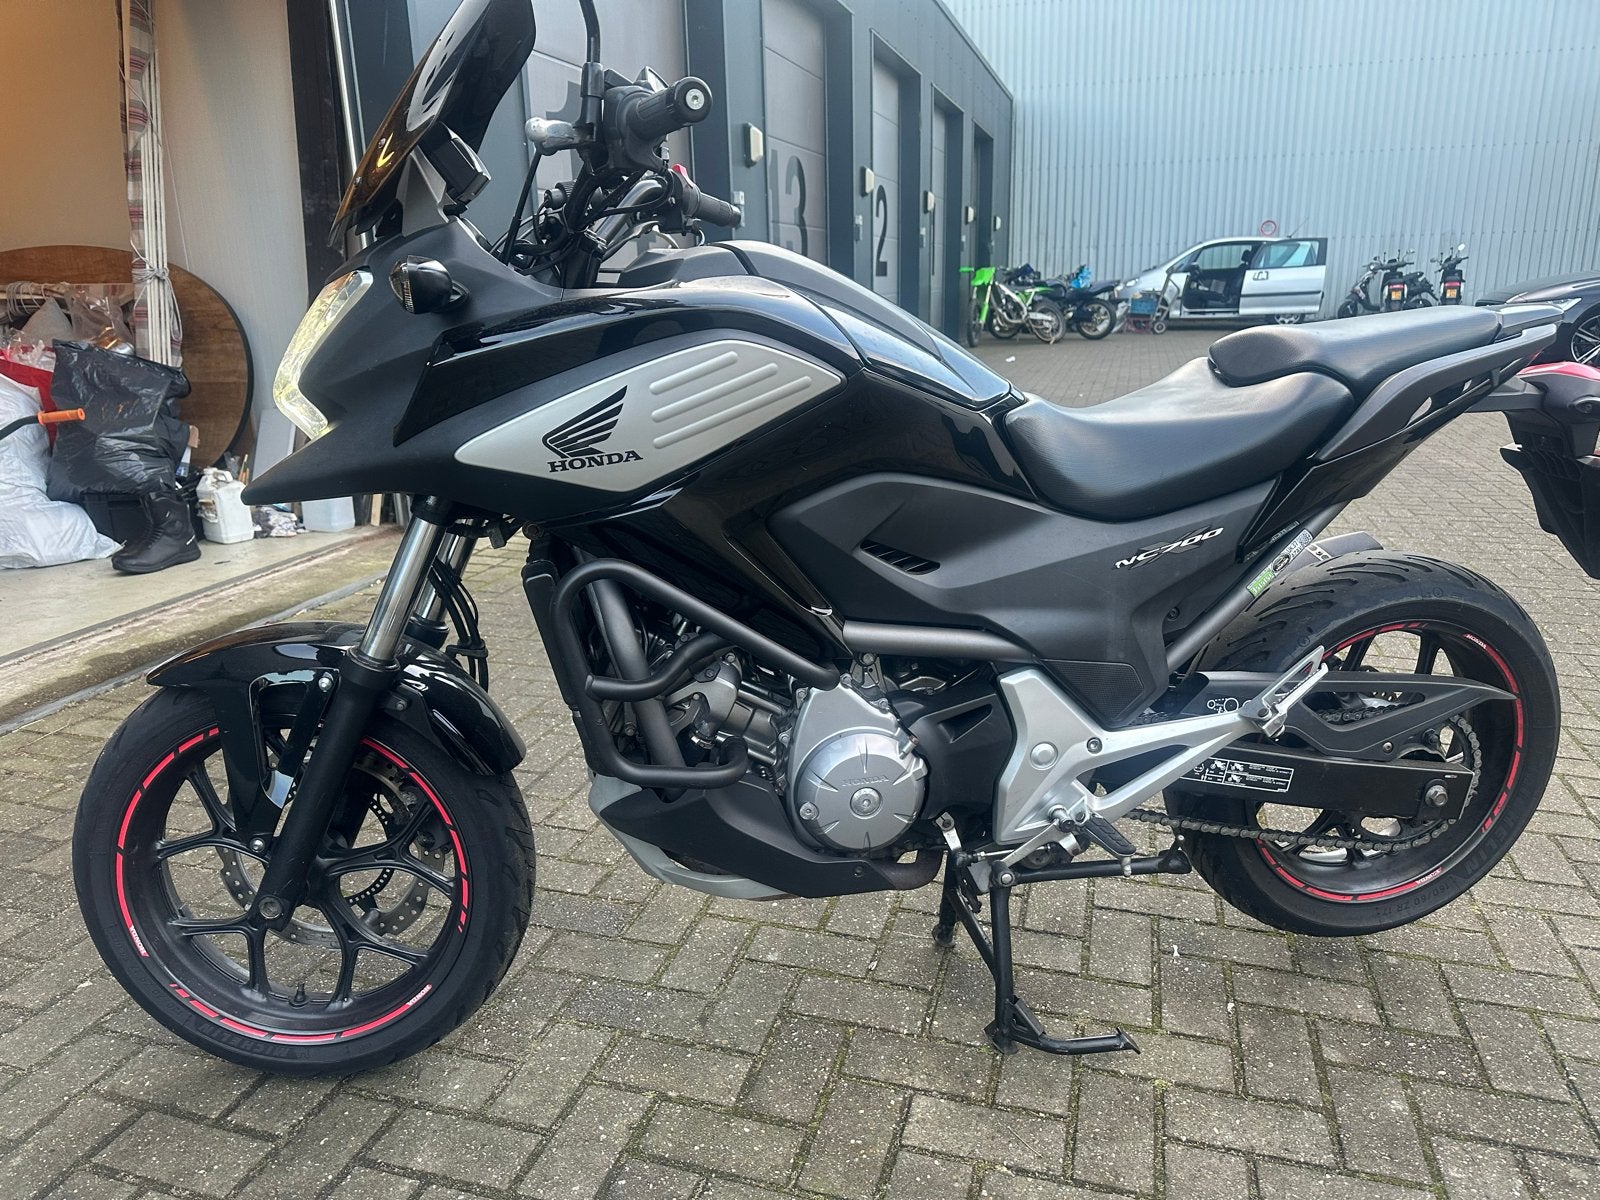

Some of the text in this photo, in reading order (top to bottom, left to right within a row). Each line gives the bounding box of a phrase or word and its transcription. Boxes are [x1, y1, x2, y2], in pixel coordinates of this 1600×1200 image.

[547, 450, 643, 472] HONDA
[1114, 527, 1224, 569] NC700
[1466, 634, 1487, 648] HONDA
[841, 775, 889, 786] HONDA
[129, 926, 147, 954] HONDA
[407, 984, 430, 1004] HONDA
[199, 1022, 290, 1056] MICHELIN
